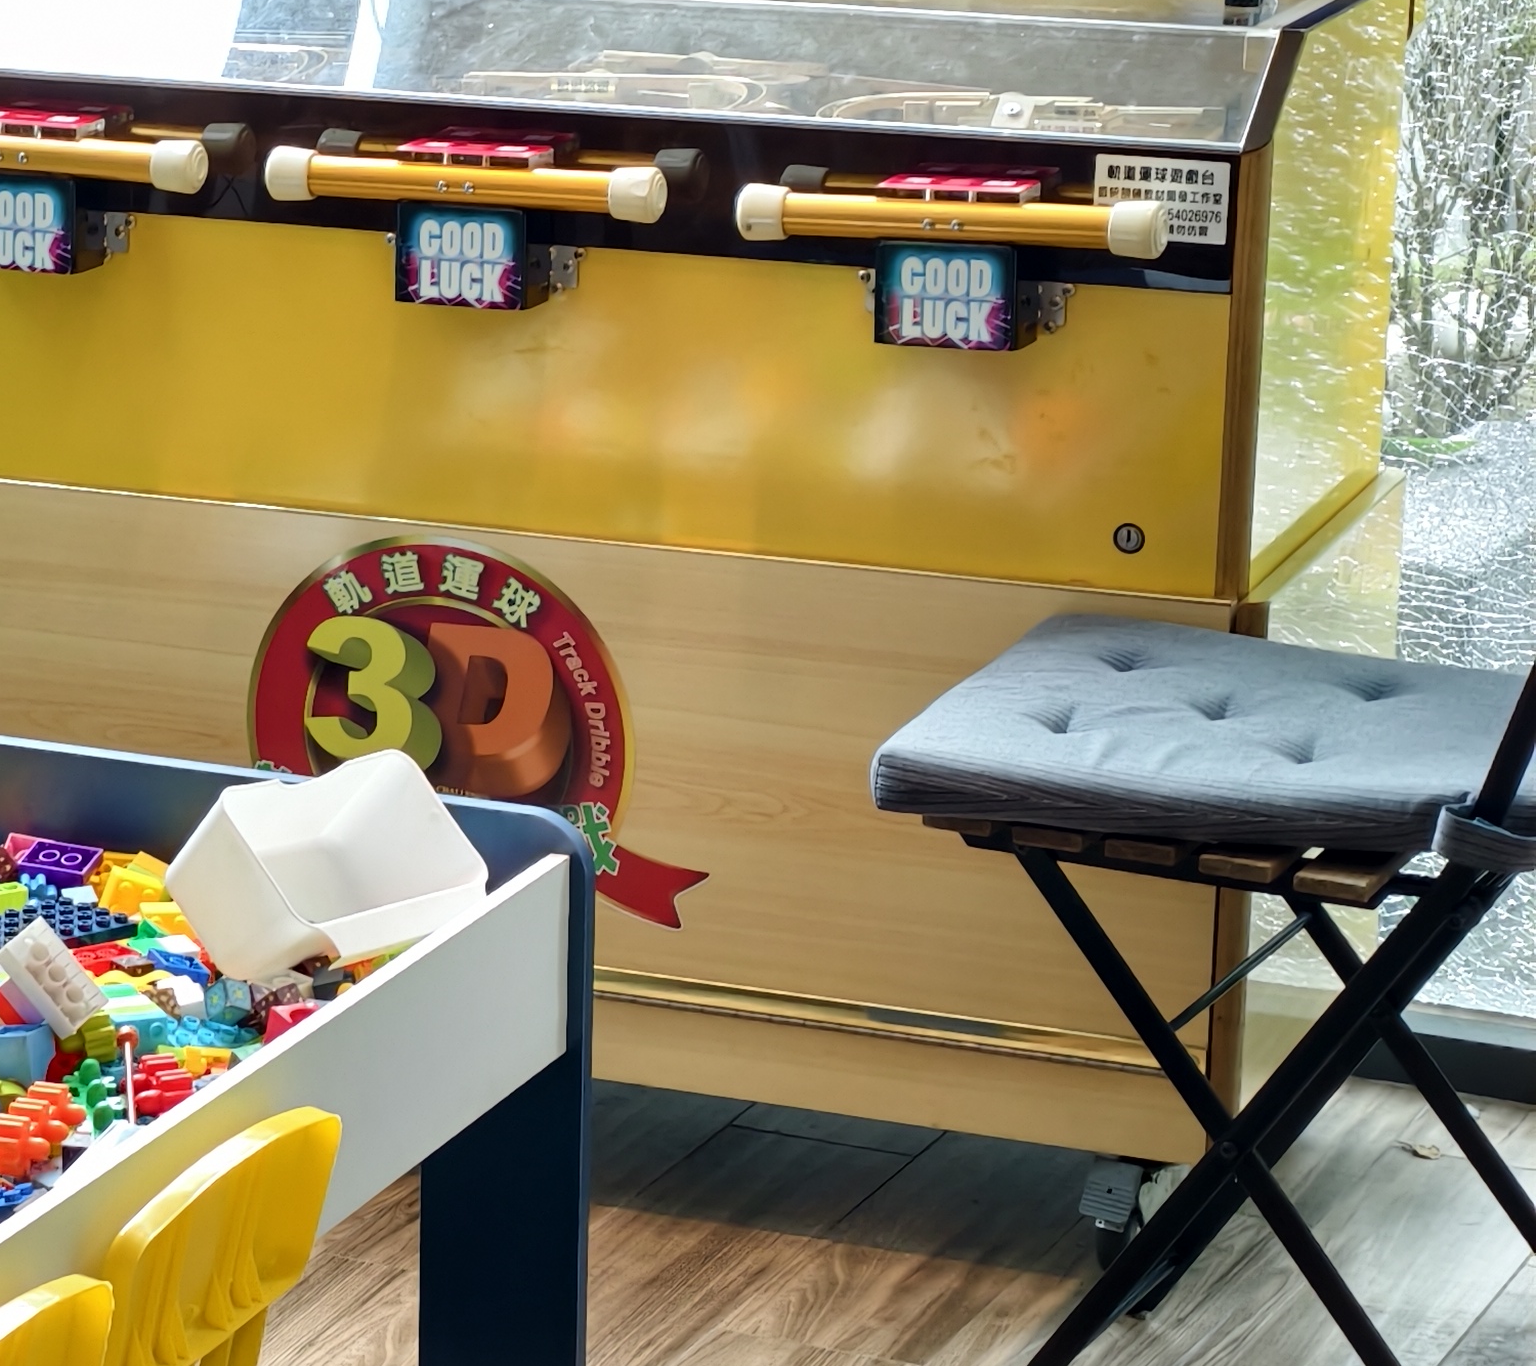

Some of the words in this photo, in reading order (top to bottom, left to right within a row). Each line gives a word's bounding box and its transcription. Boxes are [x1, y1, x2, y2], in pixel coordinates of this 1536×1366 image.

[1168, 208, 1222, 224] 54026976
[419, 219, 505, 259] GOOD
[420, 259, 505, 303] LUCK
[901, 256, 992, 298] GOOD
[902, 297, 994, 342] LUCK
[323, 551, 541, 628] 軌道運球
[553, 631, 598, 697] Track
[305, 615, 571, 797] 3D
